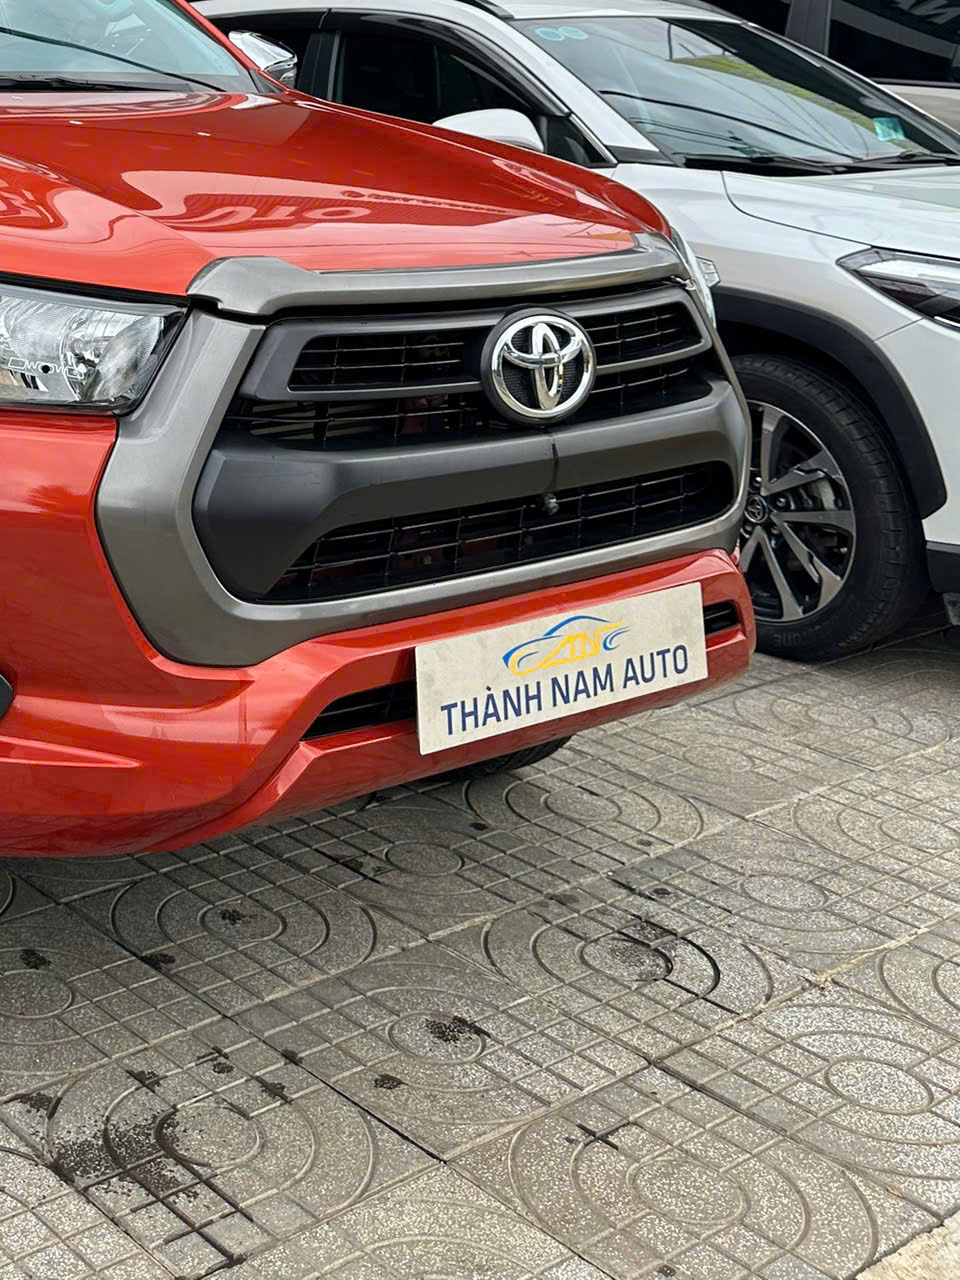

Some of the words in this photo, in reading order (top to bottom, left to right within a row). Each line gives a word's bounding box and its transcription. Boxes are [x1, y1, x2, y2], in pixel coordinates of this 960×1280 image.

[440, 681, 542, 736] THÀNH
[551, 663, 615, 708] NAM
[622, 644, 688, 689] AUTO
